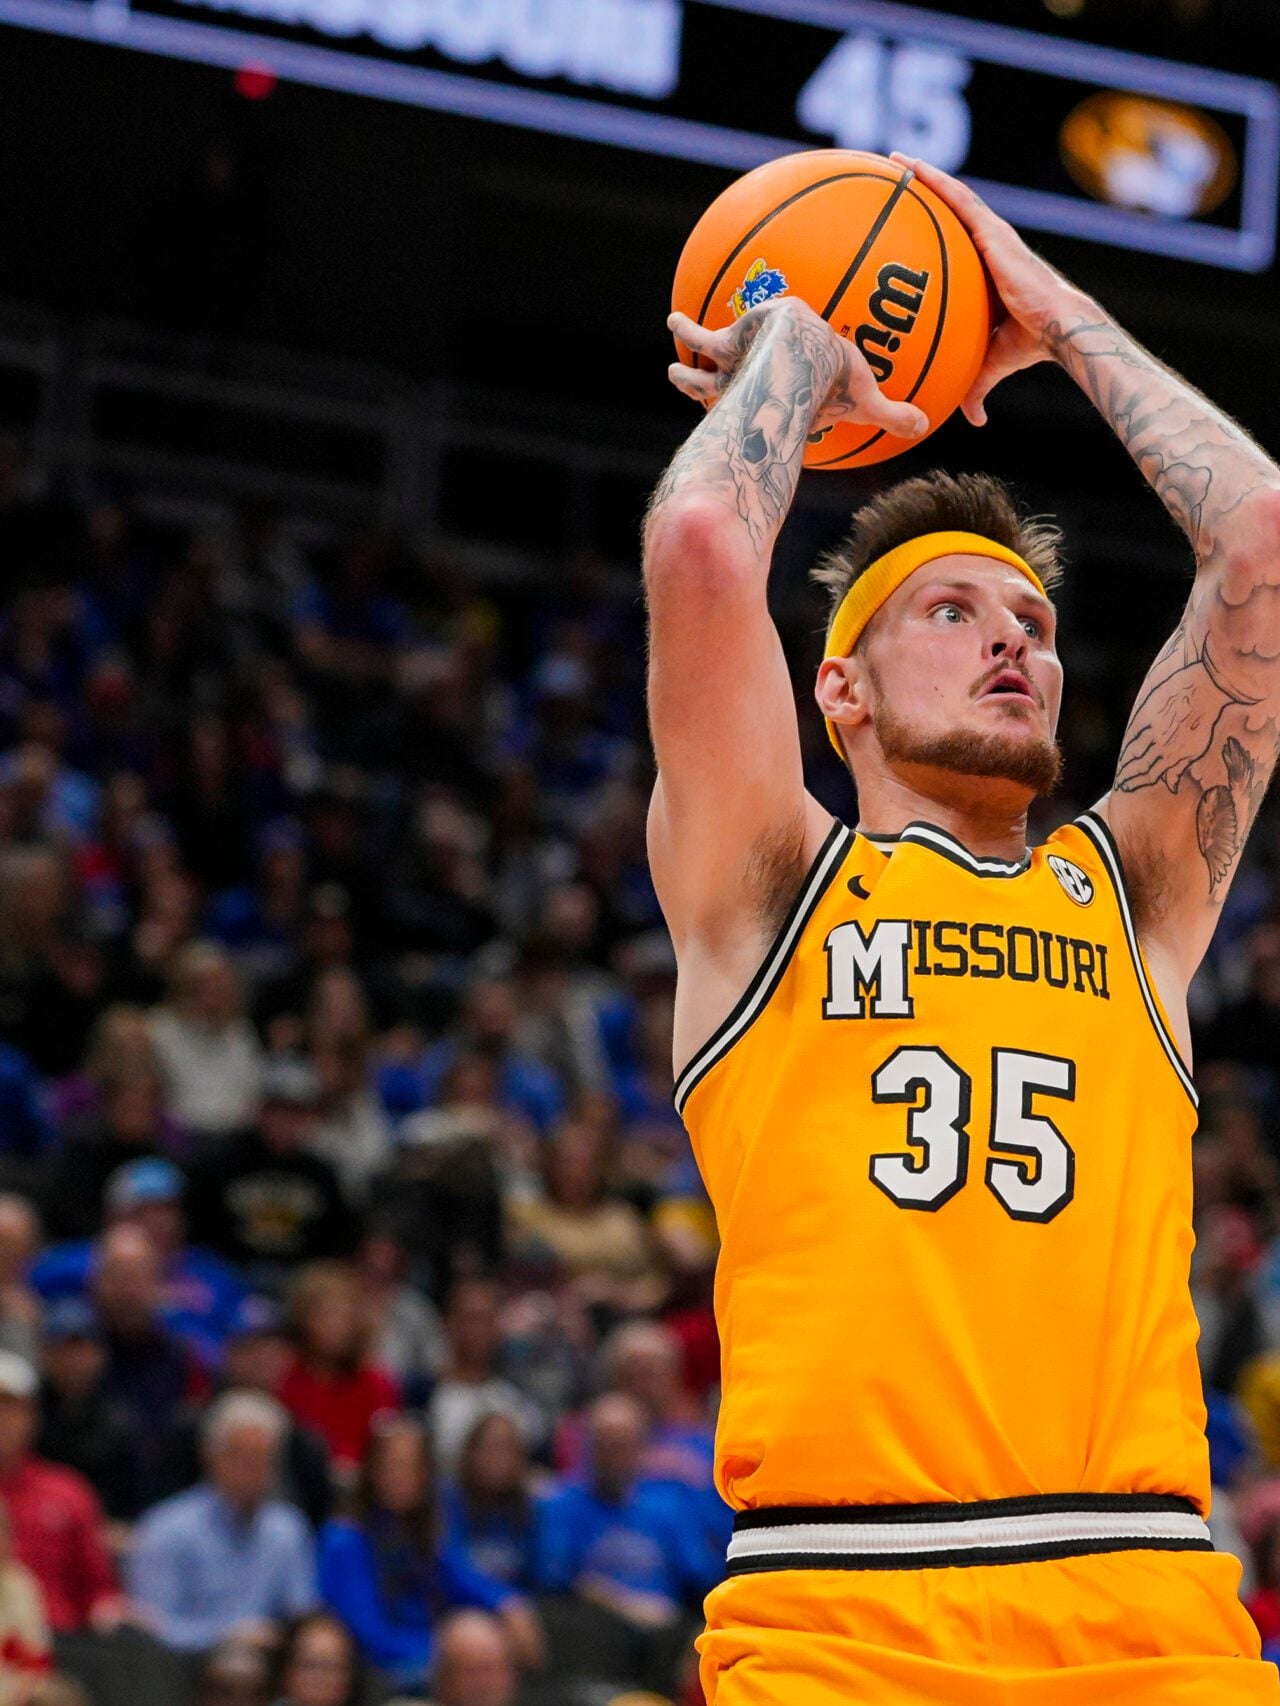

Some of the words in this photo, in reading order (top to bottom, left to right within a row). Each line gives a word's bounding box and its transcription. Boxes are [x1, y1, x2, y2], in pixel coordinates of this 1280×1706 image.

[797, 28, 973, 174] 45
[1047, 854, 1093, 904] SEC
[822, 919, 1110, 1019] MISSOURI
[869, 1045, 1076, 1224] 35
